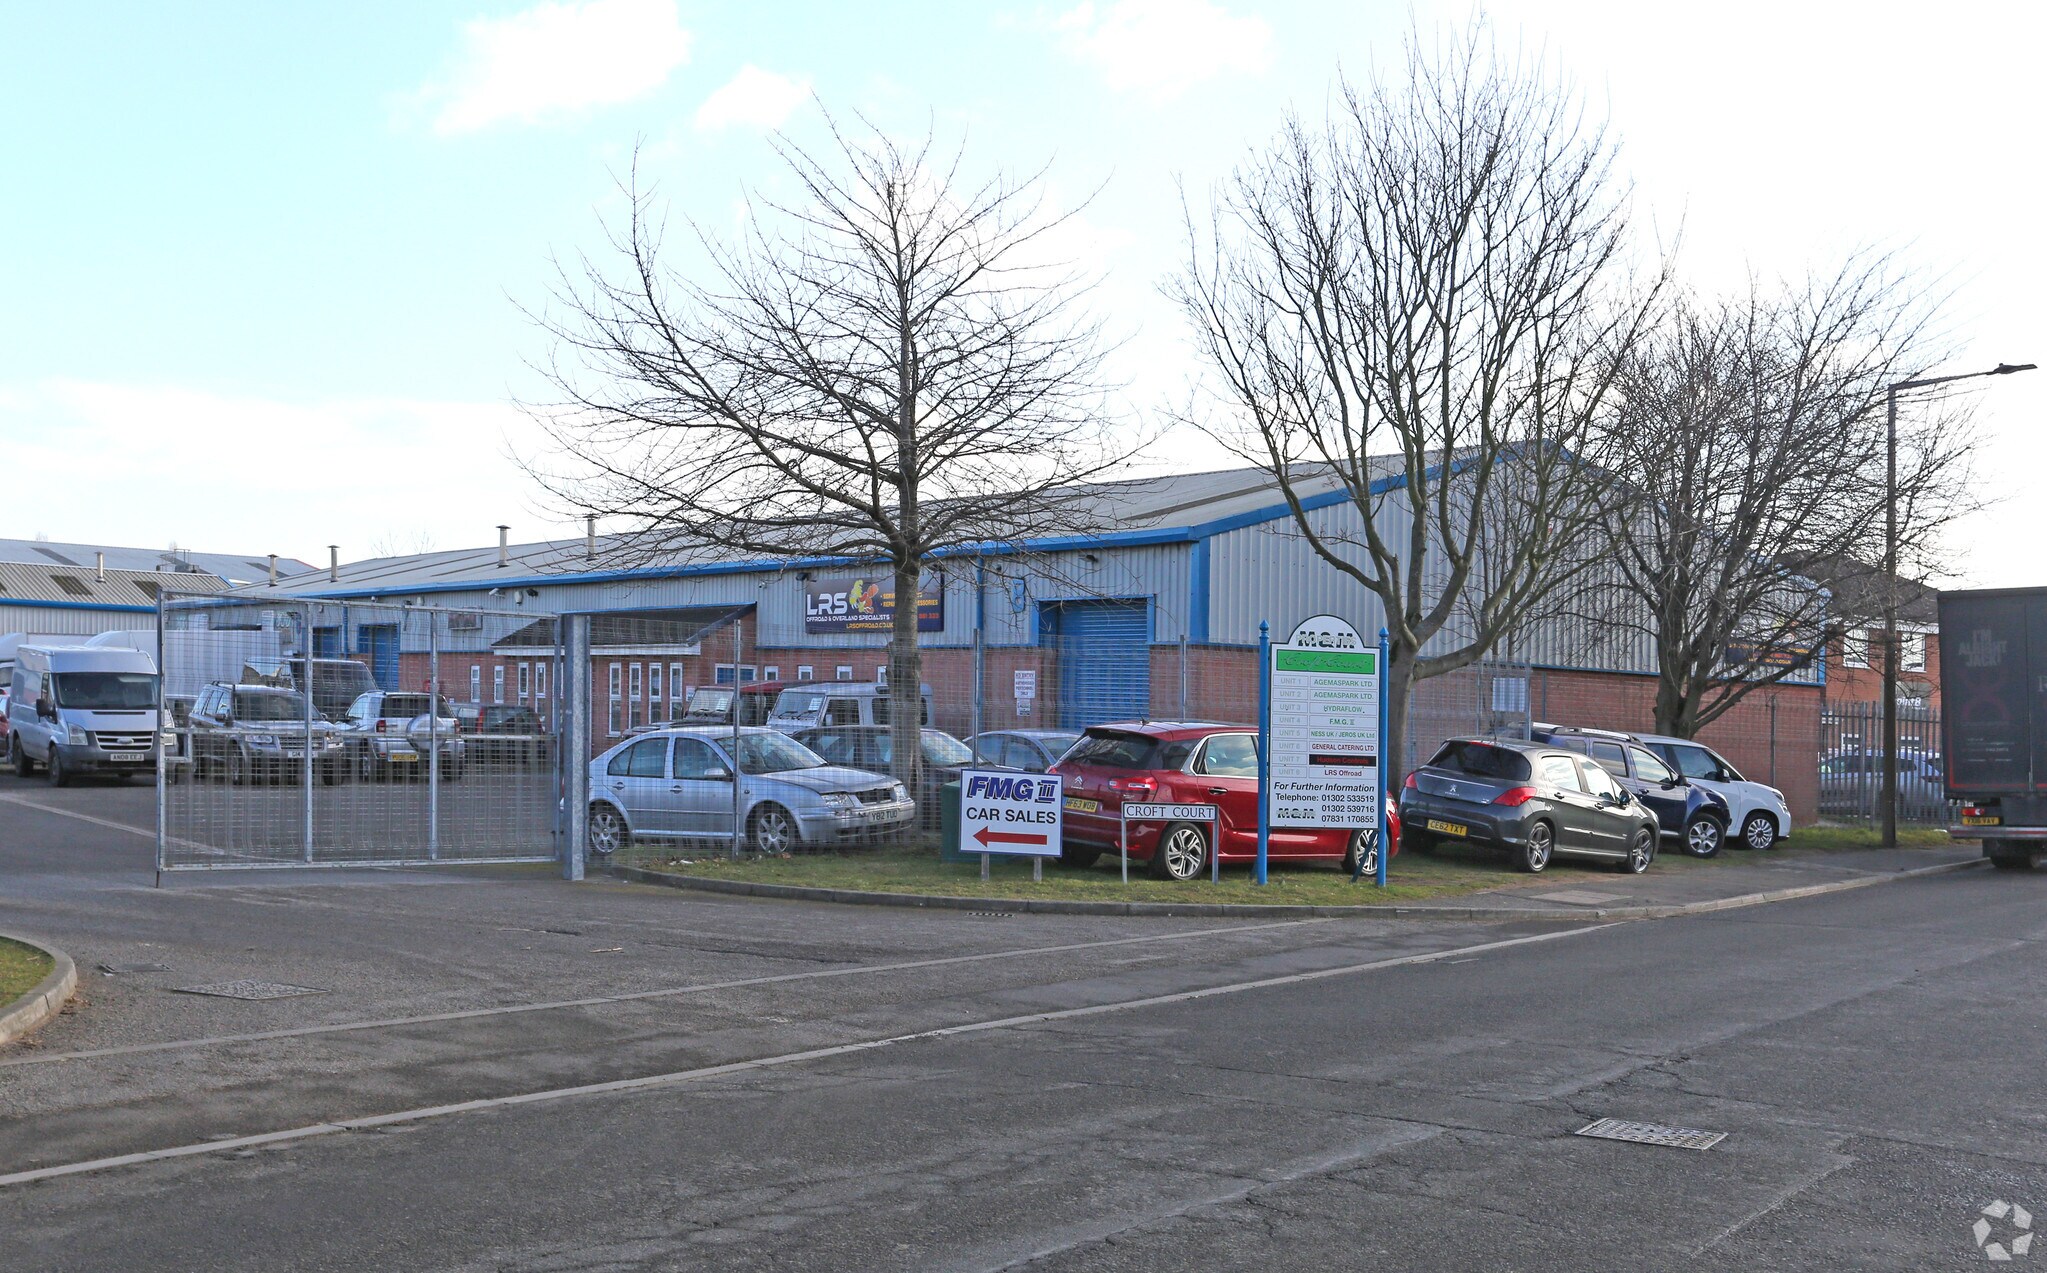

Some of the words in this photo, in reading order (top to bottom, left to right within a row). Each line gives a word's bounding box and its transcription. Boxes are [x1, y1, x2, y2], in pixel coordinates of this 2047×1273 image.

[806, 592, 848, 615] LRS
[1314, 679, 1359, 687] AGEMASPARK
[1314, 691, 1358, 699] AGEMASPARK
[967, 776, 1034, 801] FMG
[1274, 782, 1289, 790] For
[1291, 782, 1322, 791] Further
[1325, 783, 1375, 792] Information
[1275, 793, 1319, 802] Telephone:
[1321, 794, 1345, 802] 01302
[1347, 795, 1375, 803] 533519
[1126, 805, 1166, 817] CROFT
[1172, 806, 1214, 818] COURT
[1321, 804, 1345, 812] 01302
[1347, 805, 1375, 813] 539716
[966, 807, 1000, 821] CAR
[1005, 809, 1057, 824] SALES
[1321, 815, 1344, 823] 07831
[1347, 815, 1375, 823] 170855
[1430, 820, 1449, 831] CE62
[1450, 824, 1464, 834] TXT
